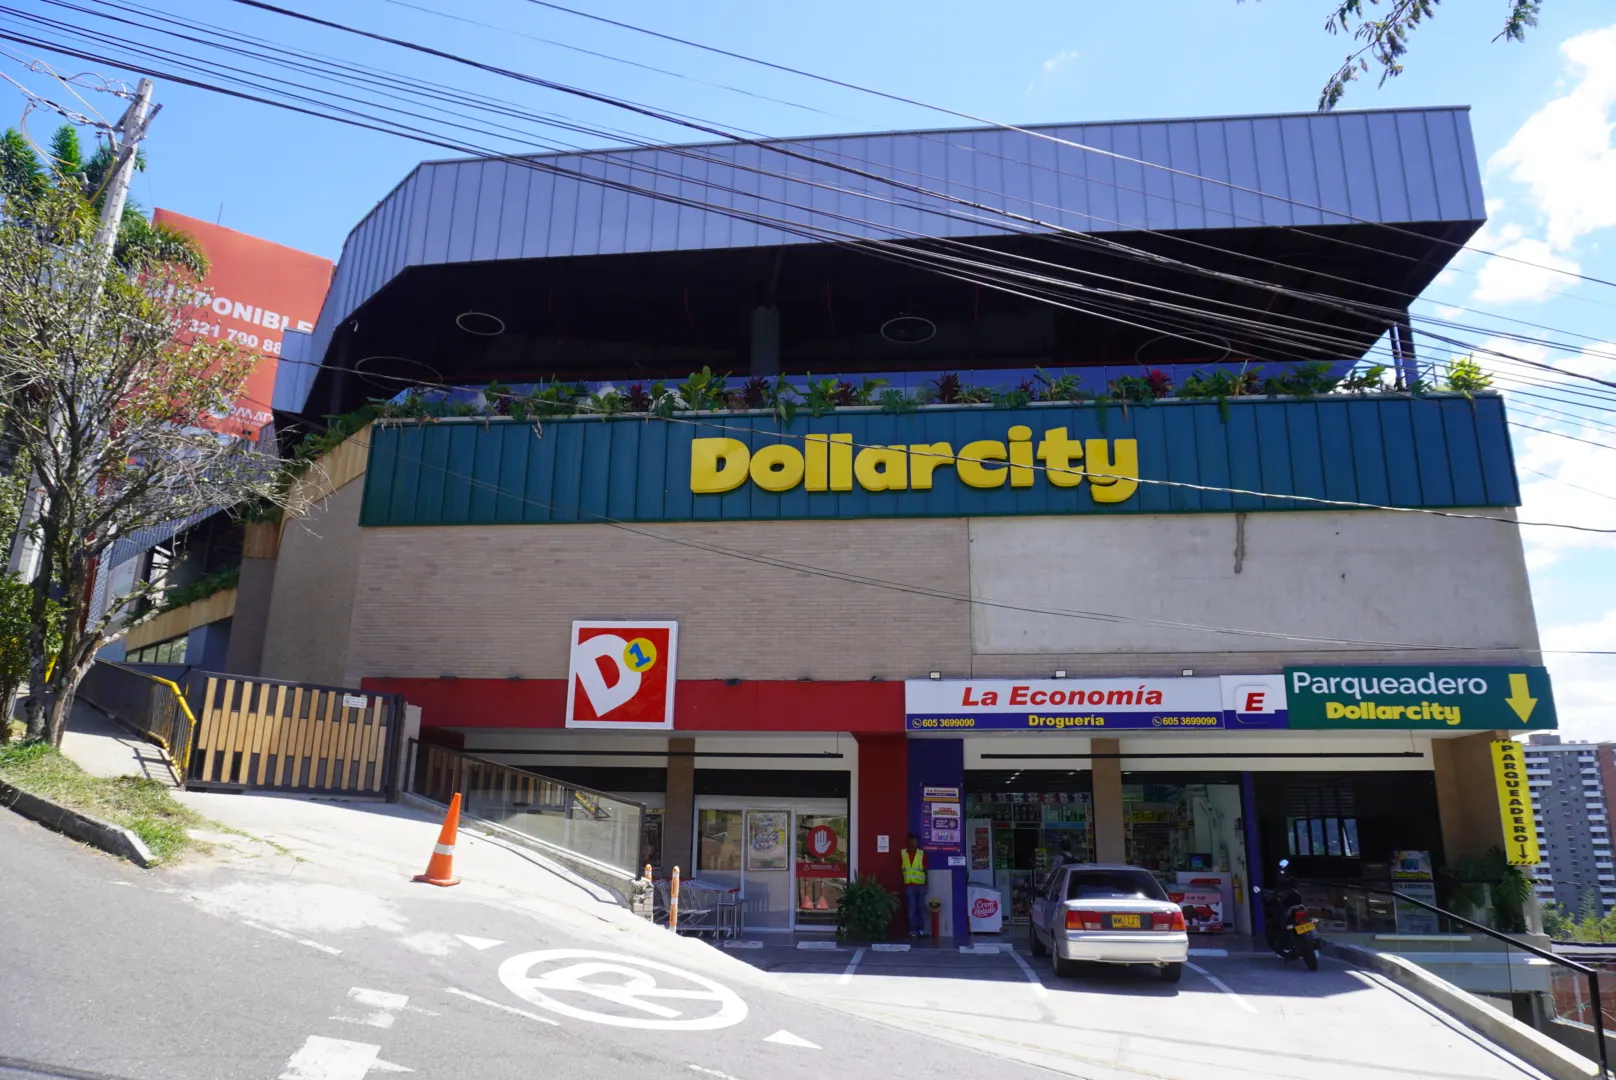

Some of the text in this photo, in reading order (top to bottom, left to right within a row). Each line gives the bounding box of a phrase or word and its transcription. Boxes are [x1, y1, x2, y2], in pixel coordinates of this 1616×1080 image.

[690, 425, 1139, 503] Dollarcity
[962, 685, 1163, 706] La Economía
[1292, 671, 1488, 700] Parqueadero
[1245, 692, 1265, 712] E
[922, 718, 975, 728] 605 3699090
[1028, 714, 1105, 728] Droguería
[1163, 716, 1217, 726] 605 3699090
[1325, 701, 1462, 726] Dollarcity
[1501, 745, 1528, 842] PARQUEADERO
